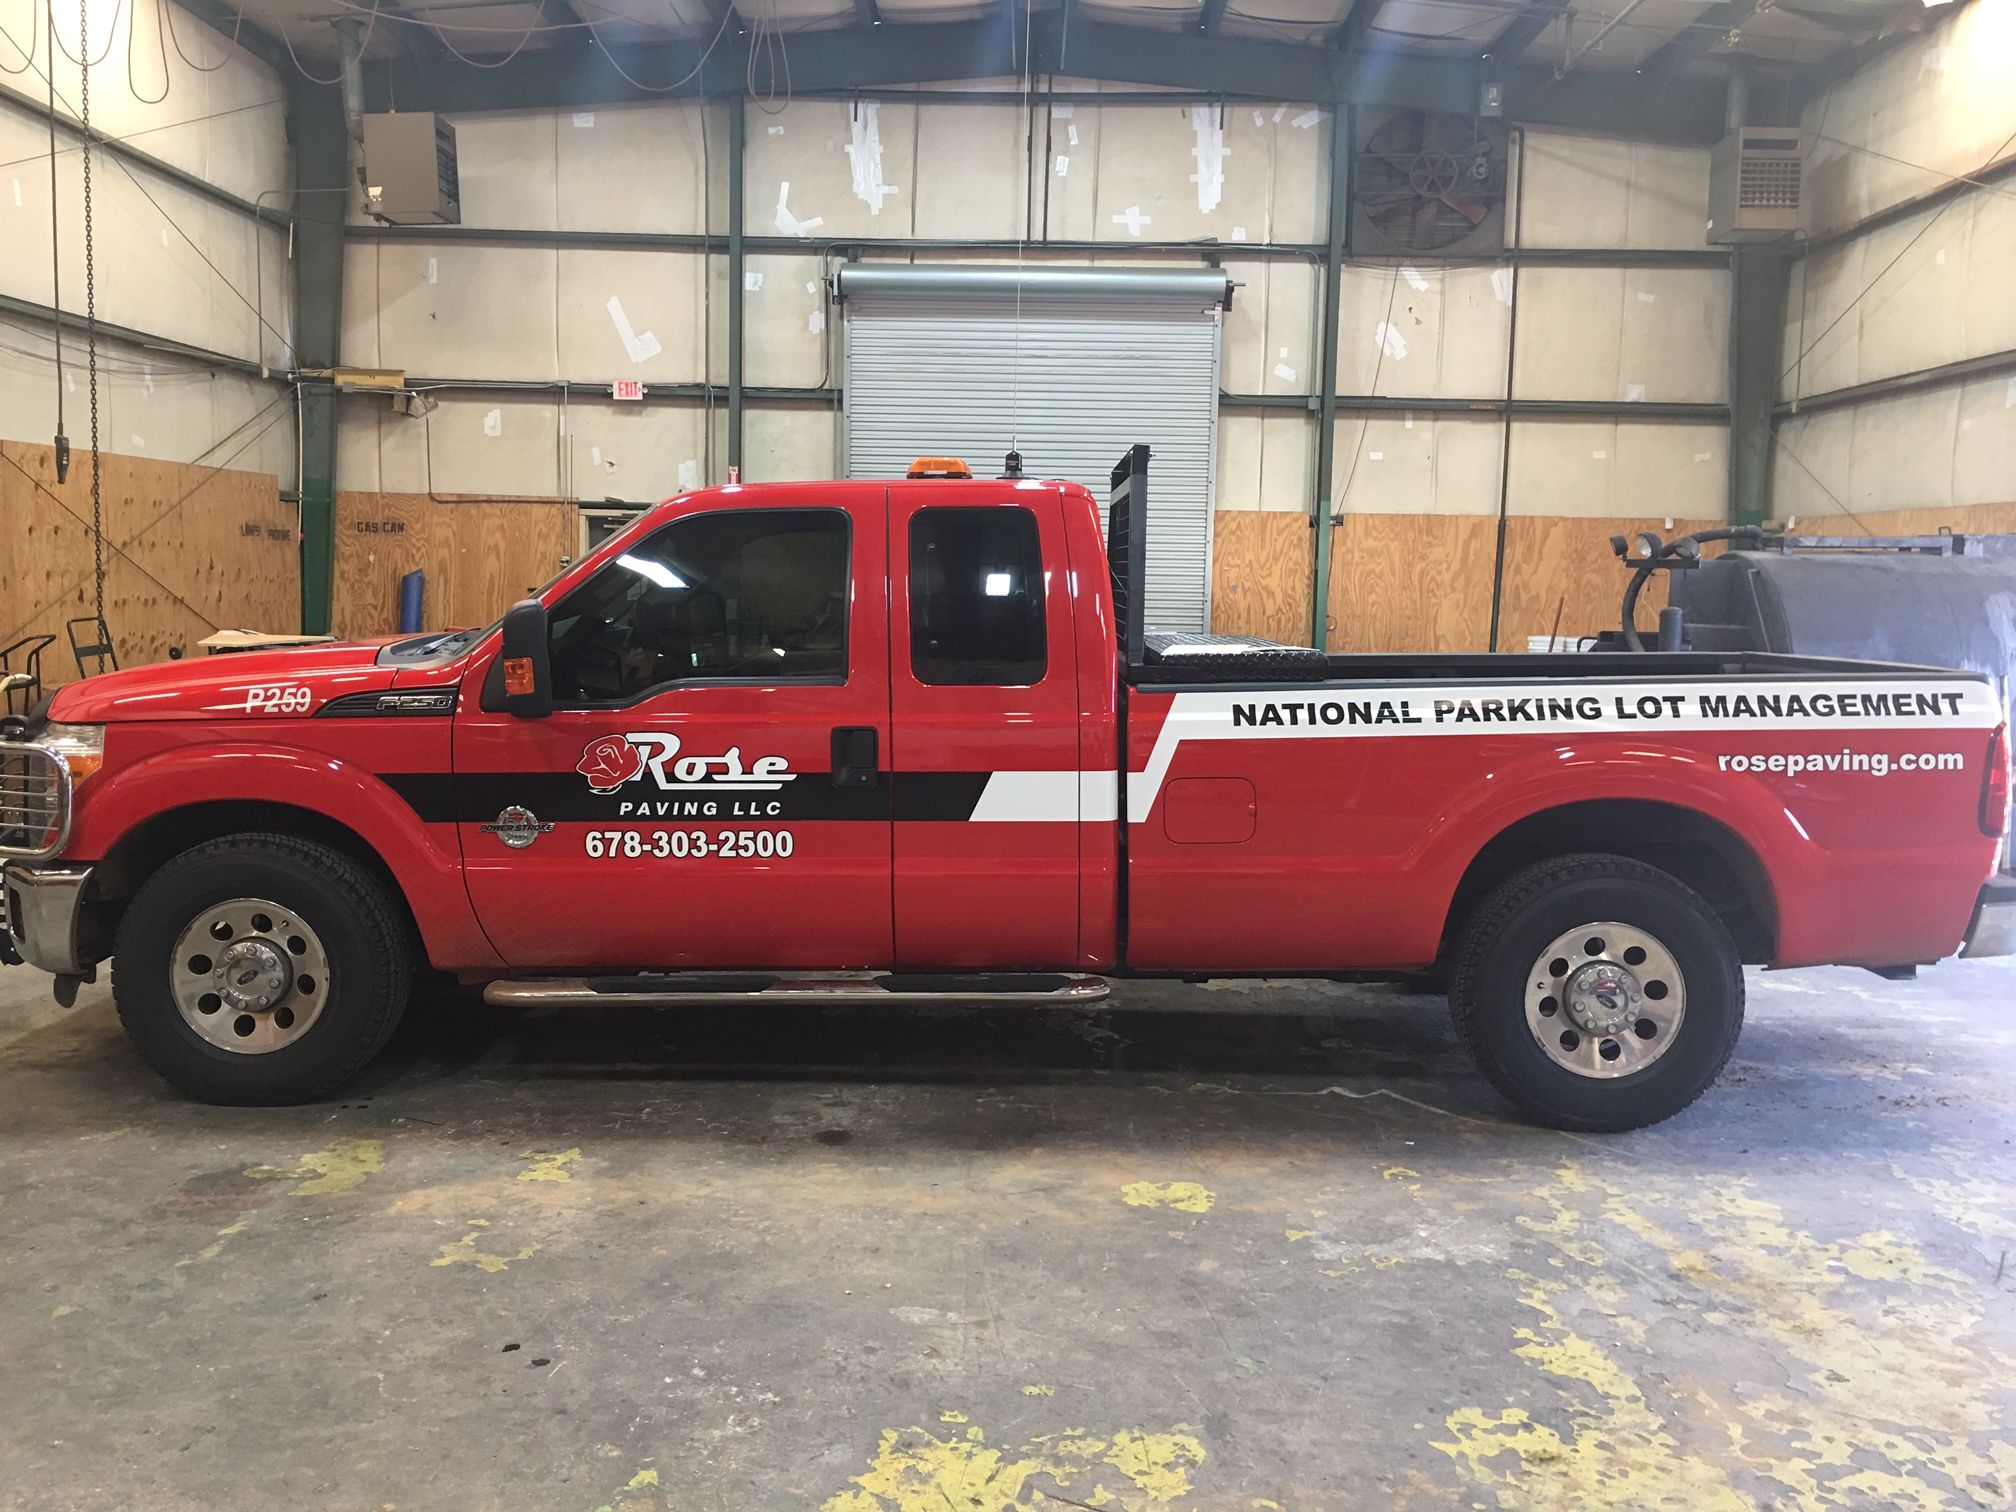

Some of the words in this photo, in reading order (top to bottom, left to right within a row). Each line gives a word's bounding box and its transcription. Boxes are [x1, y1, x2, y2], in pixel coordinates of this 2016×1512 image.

[618, 381, 639, 398] EXIT
[357, 521, 379, 533] GAS
[382, 521, 405, 534] CAN
[245, 687, 311, 713] P259
[1232, 701, 1422, 727] NATIONAL
[1433, 697, 1602, 723] PARKING
[1614, 696, 1685, 720] LOT
[1700, 693, 1963, 718] MANAGEMENT
[626, 732, 798, 791] Rose
[1718, 749, 1964, 776] rosepaving.com
[619, 801, 718, 816] PAVING
[733, 801, 782, 816] LLC
[515, 824, 555, 832] STROKE
[585, 830, 794, 858] 678-303-2500
